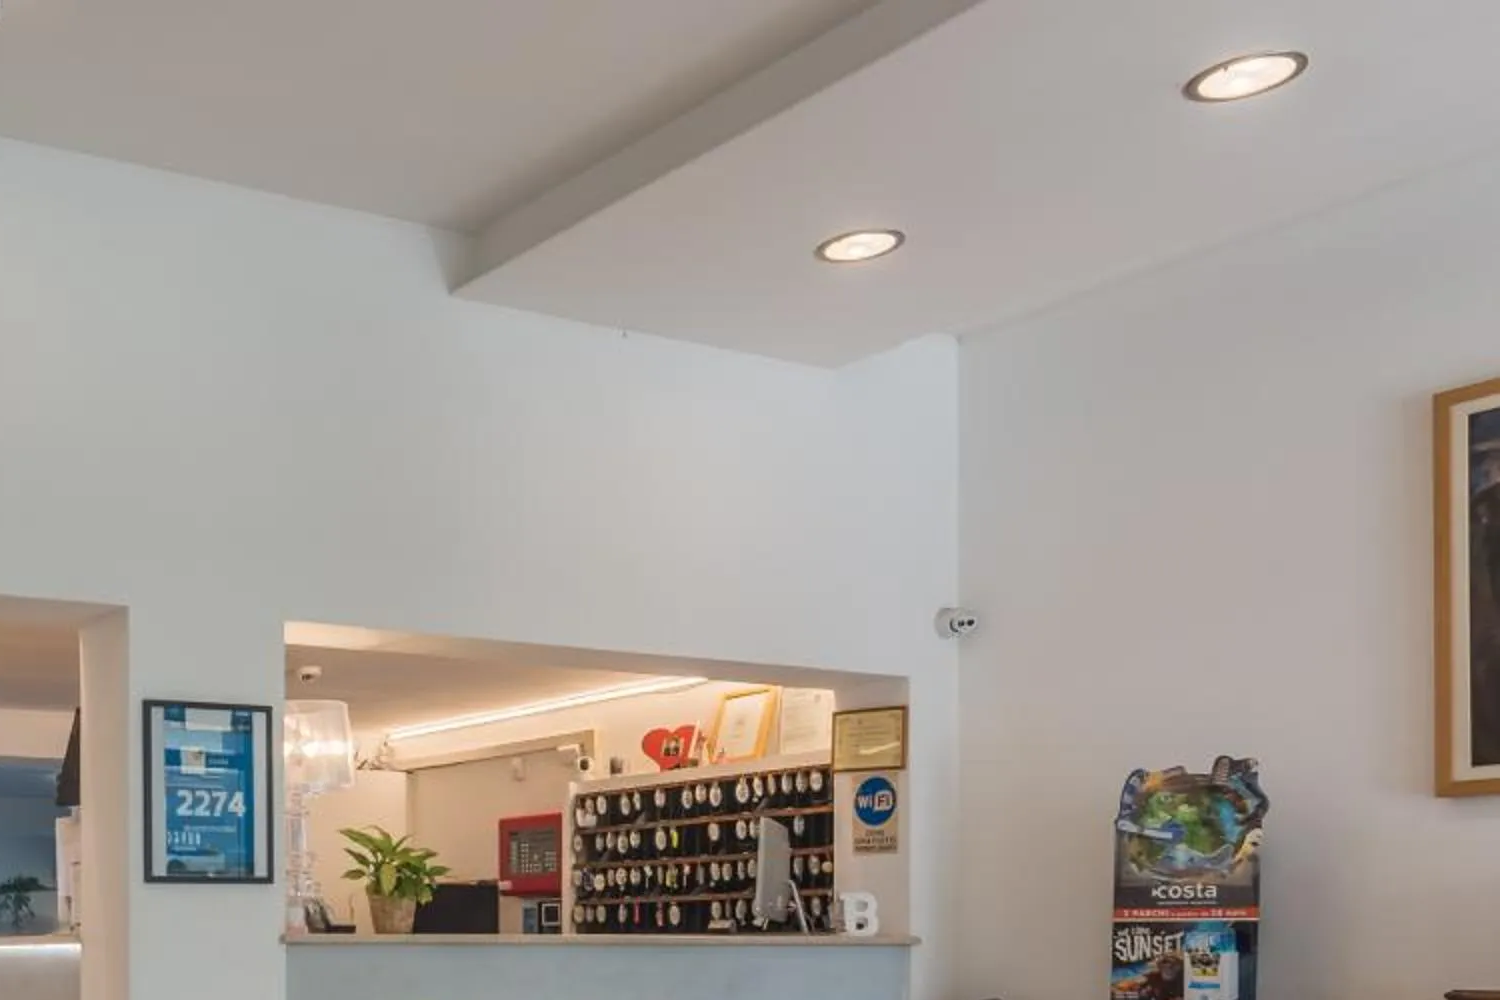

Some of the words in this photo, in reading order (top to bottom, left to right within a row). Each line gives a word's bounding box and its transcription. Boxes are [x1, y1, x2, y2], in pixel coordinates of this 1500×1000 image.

[176, 790, 246, 816] 2274
[1156, 883, 1217, 899] costa
[841, 893, 879, 936] B
[1115, 932, 1185, 961] SUNSET
